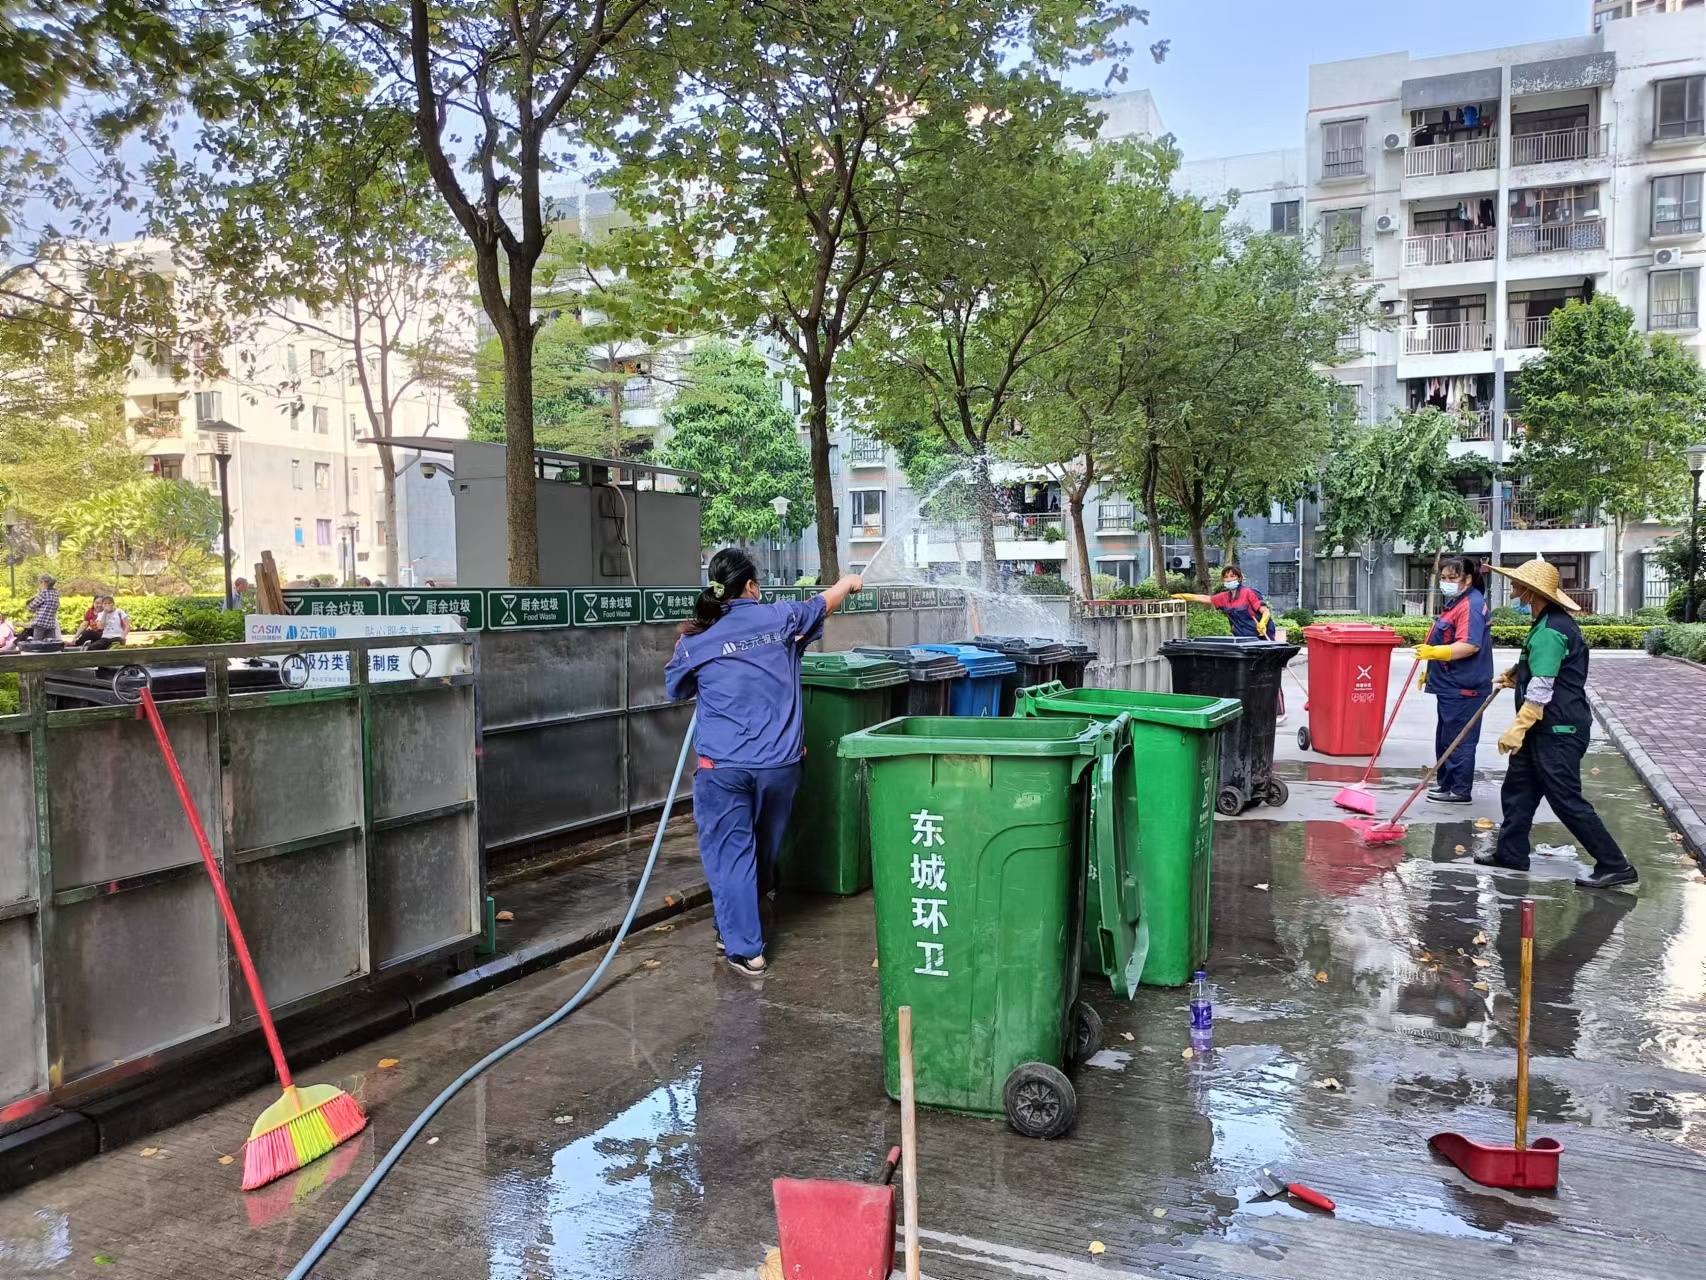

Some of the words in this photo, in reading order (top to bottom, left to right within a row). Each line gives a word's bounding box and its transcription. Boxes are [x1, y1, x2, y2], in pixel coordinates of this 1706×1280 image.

[426, 599, 471, 614] 厨余垃圾
[521, 597, 559, 611] 厨余垃圾
[600, 596, 632, 609] 厨余垃圾
[667, 595, 695, 607] 厨余垃圾
[311, 601, 365, 616] 厨余垃圾
[602, 610, 616, 618] Food
[523, 613, 539, 621] Food
[539, 612, 557, 620] Waste
[251, 624, 281, 634] CASIN
[300, 625, 336, 639] 公元物业
[740, 632, 782, 651] 公元物业
[291, 653, 400, 671] 垃圾分类制度
[910, 809, 949, 977] 东城环卫
